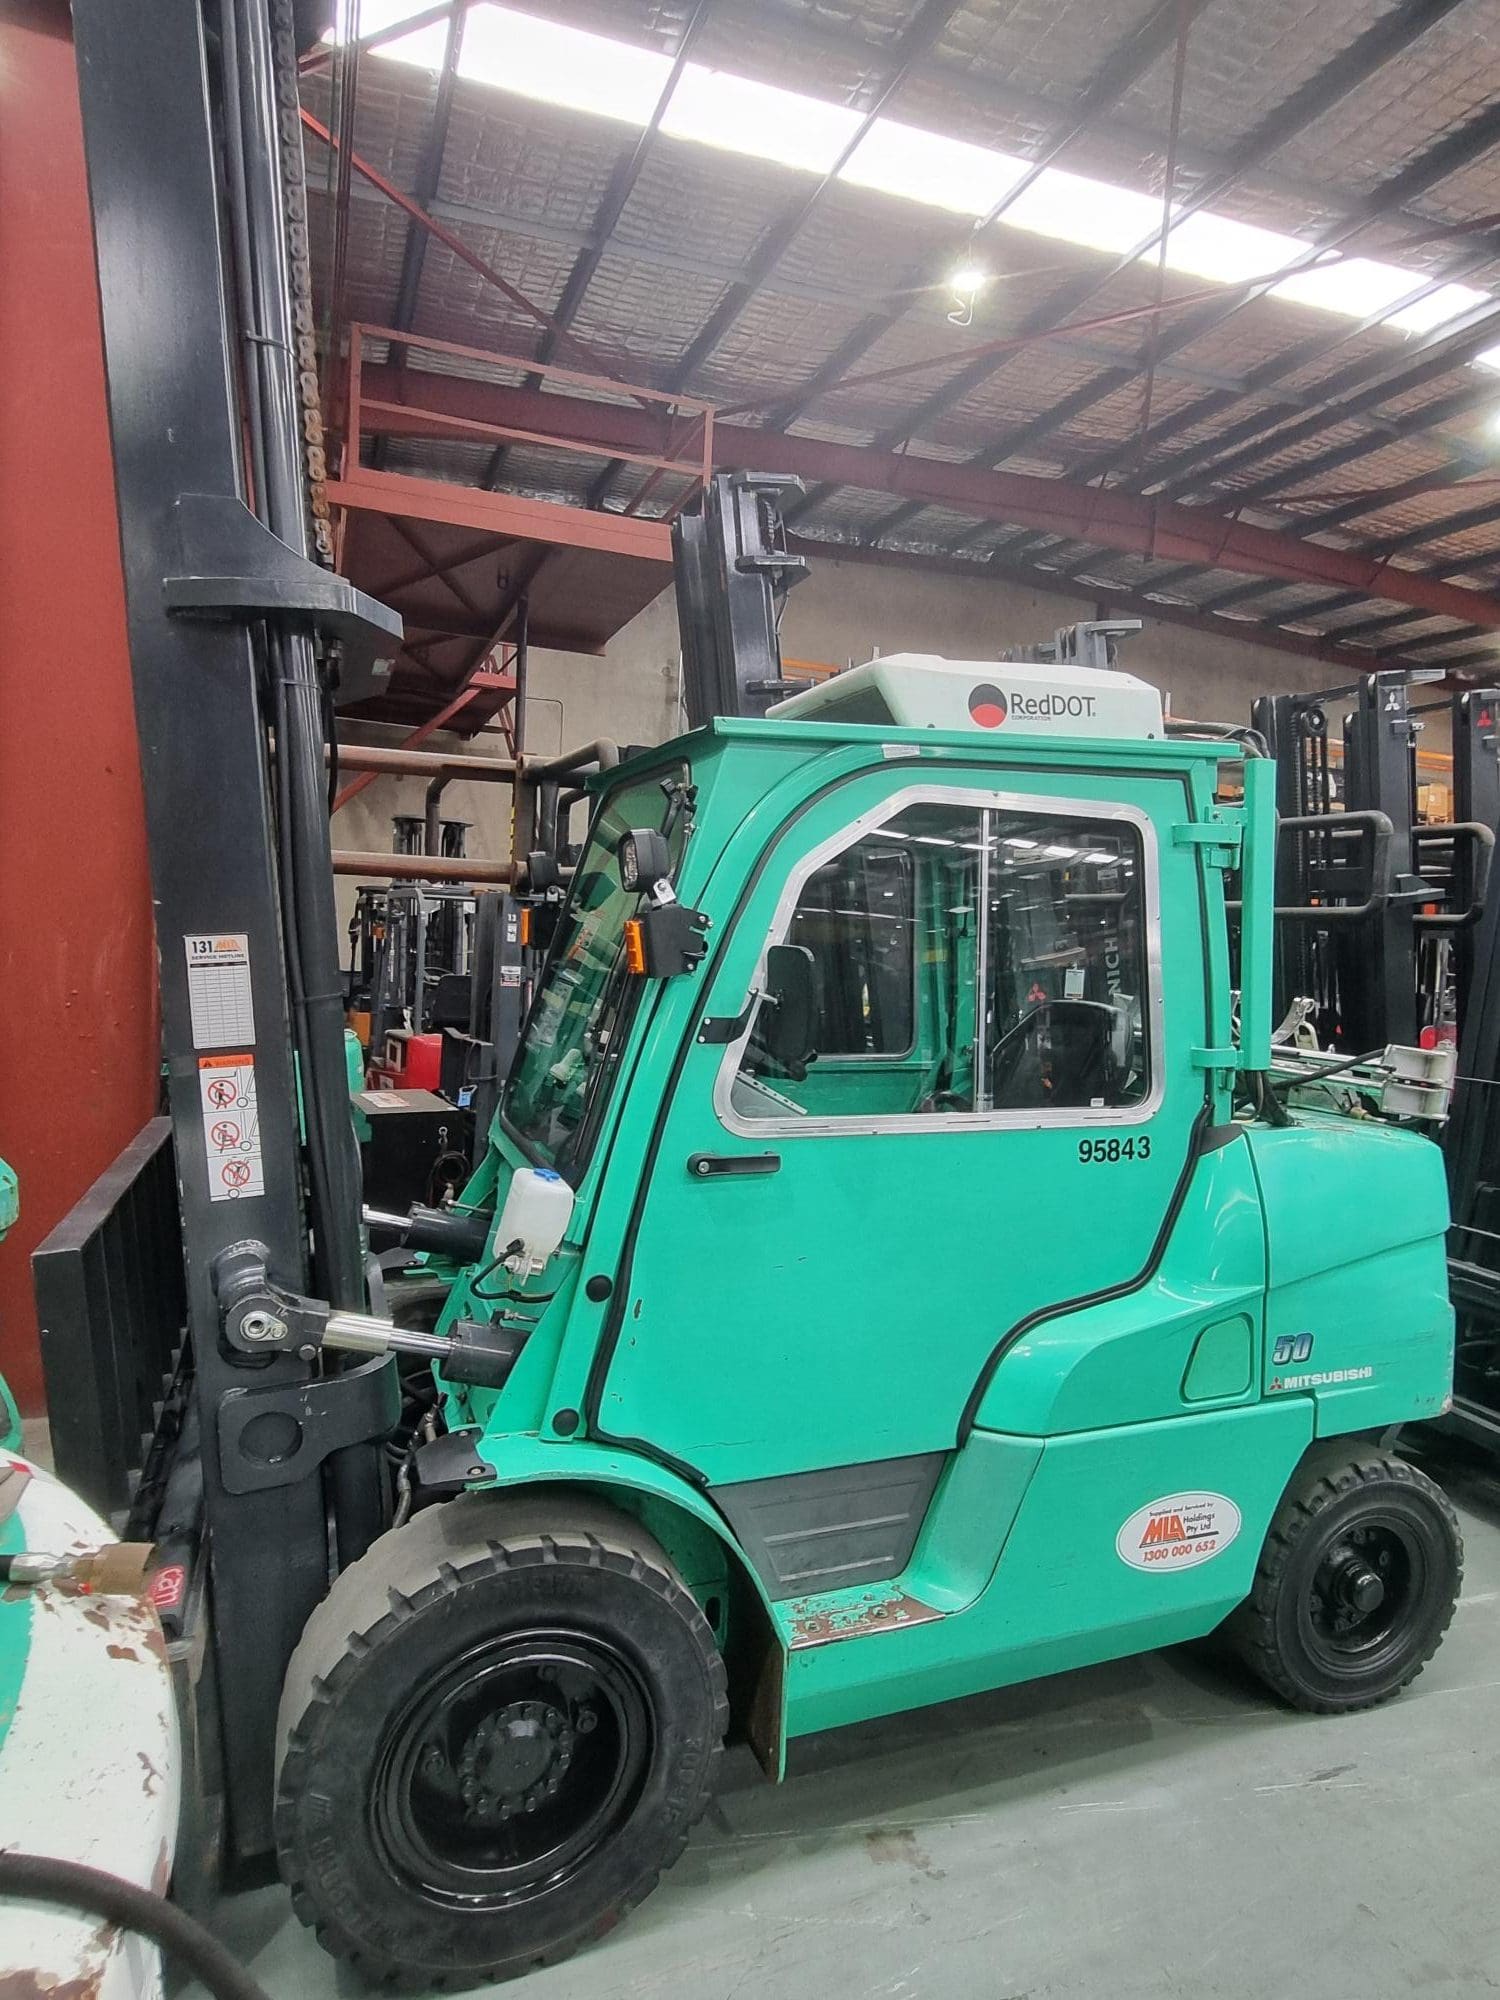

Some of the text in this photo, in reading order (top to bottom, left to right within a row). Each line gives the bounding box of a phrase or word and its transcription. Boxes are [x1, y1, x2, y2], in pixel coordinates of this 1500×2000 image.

[192, 940, 213, 953] 131
[1078, 1135, 1151, 1164] 95843
[1272, 1332, 1314, 1365] 50
[1283, 1366, 1374, 1389] MITSUBISHI
[1183, 1512, 1216, 1524] Holdings
[1186, 1521, 1212, 1534] Pty Ltd
[1143, 1539, 1217, 1562] 1300 000 652
